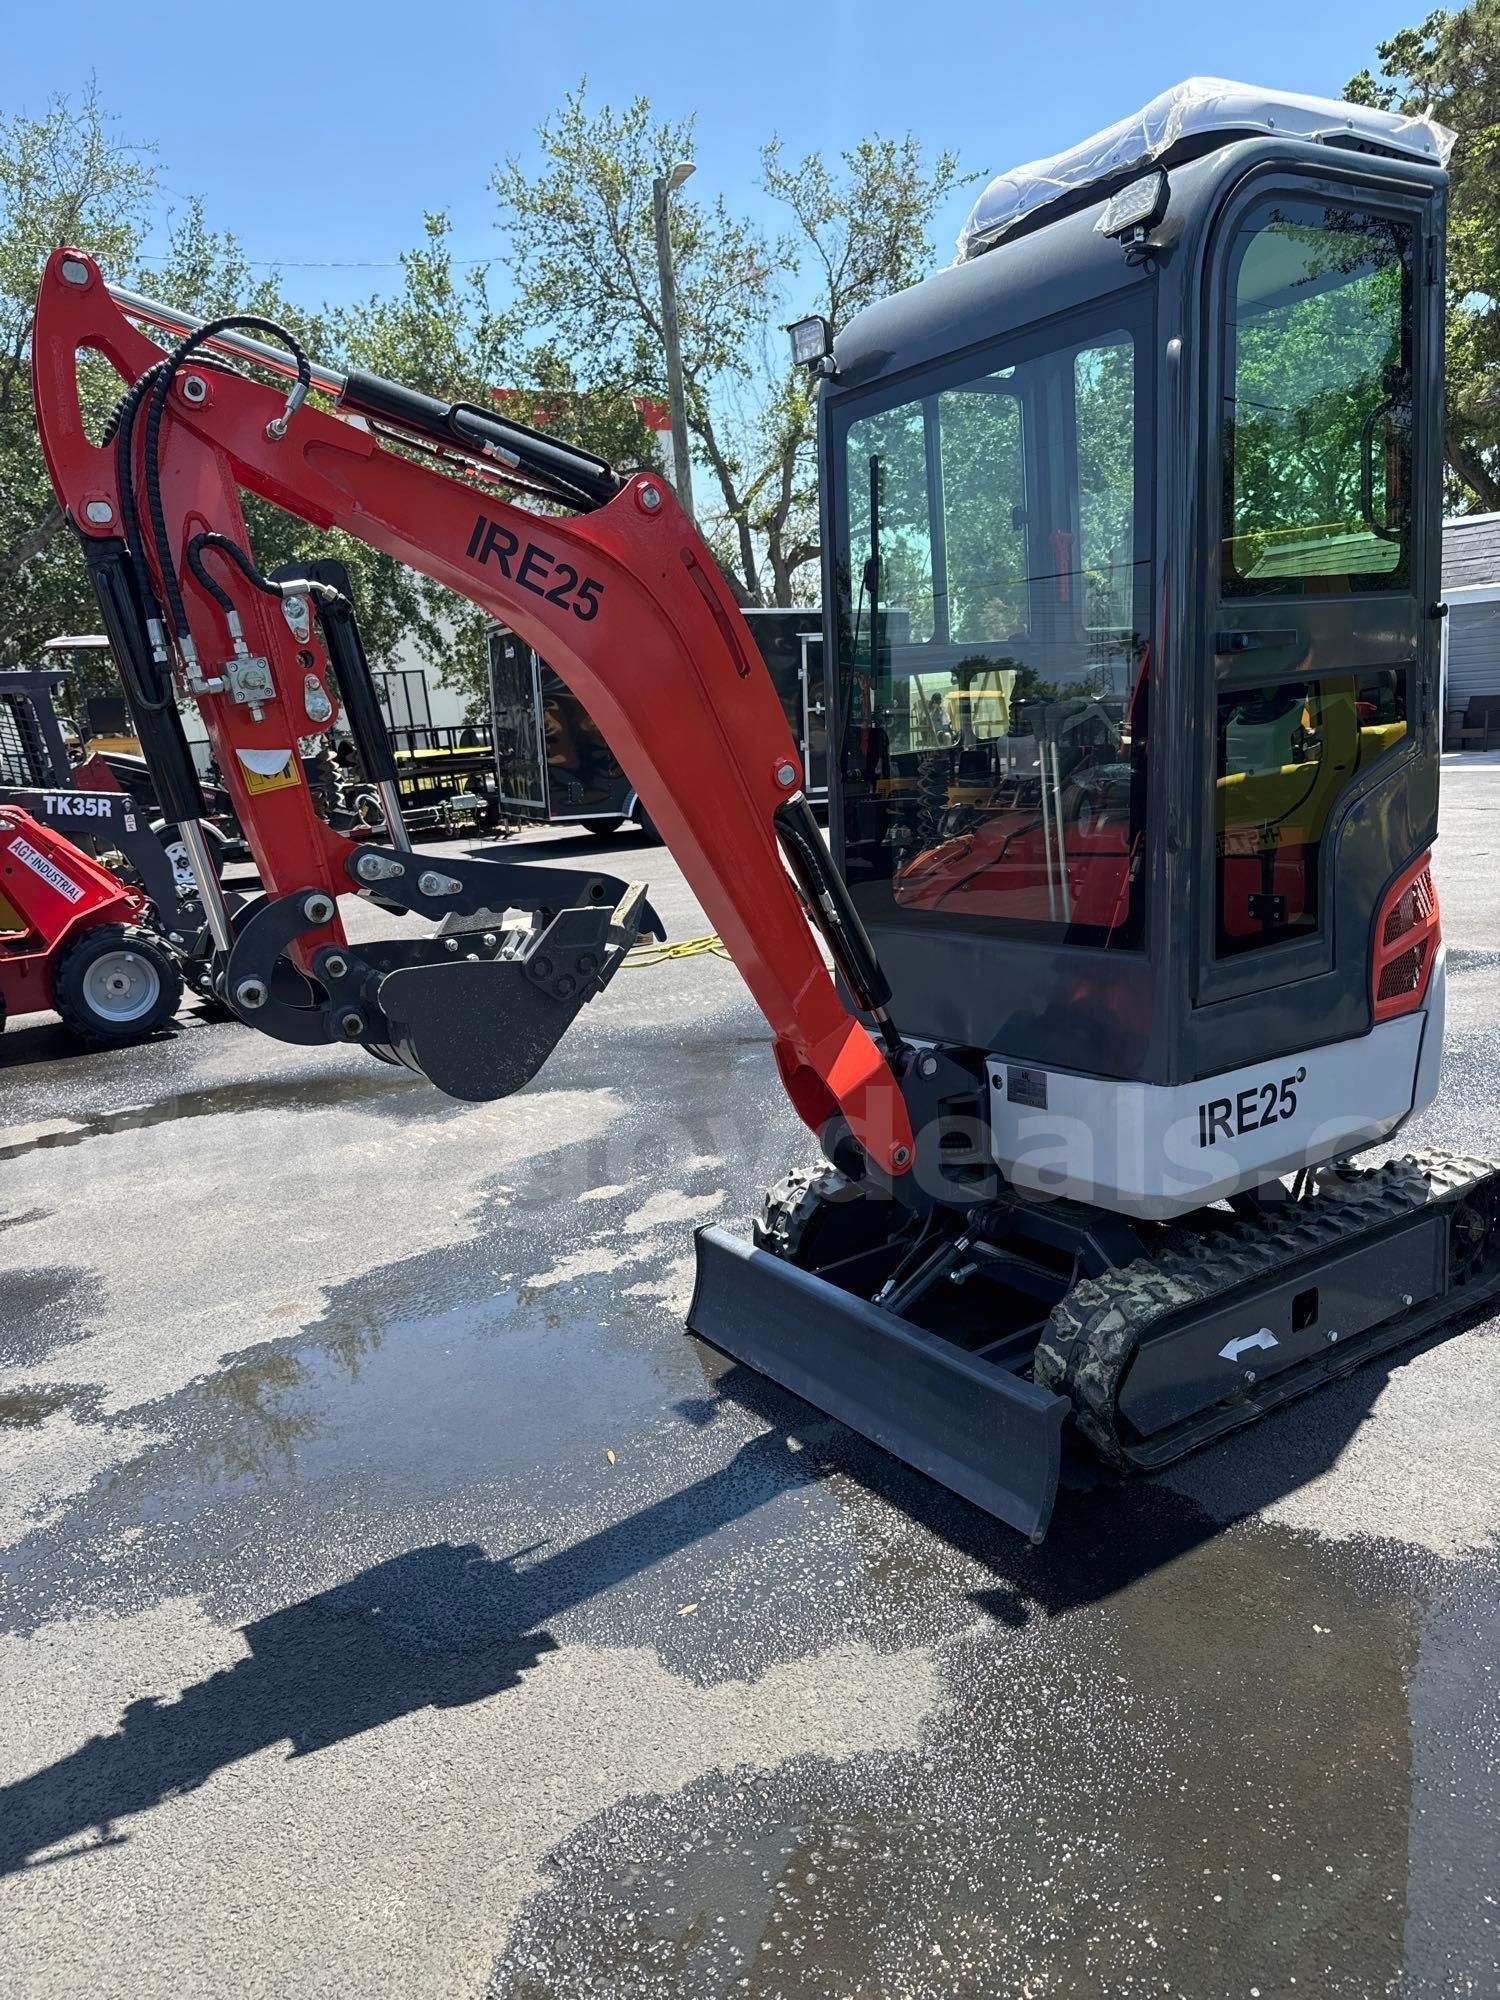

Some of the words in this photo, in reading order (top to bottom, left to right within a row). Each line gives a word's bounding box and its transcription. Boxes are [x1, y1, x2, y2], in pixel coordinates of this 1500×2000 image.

[466, 514, 604, 621] IRE25
[43, 796, 112, 817] TK35R
[1199, 1077, 1297, 1148] IRE25
